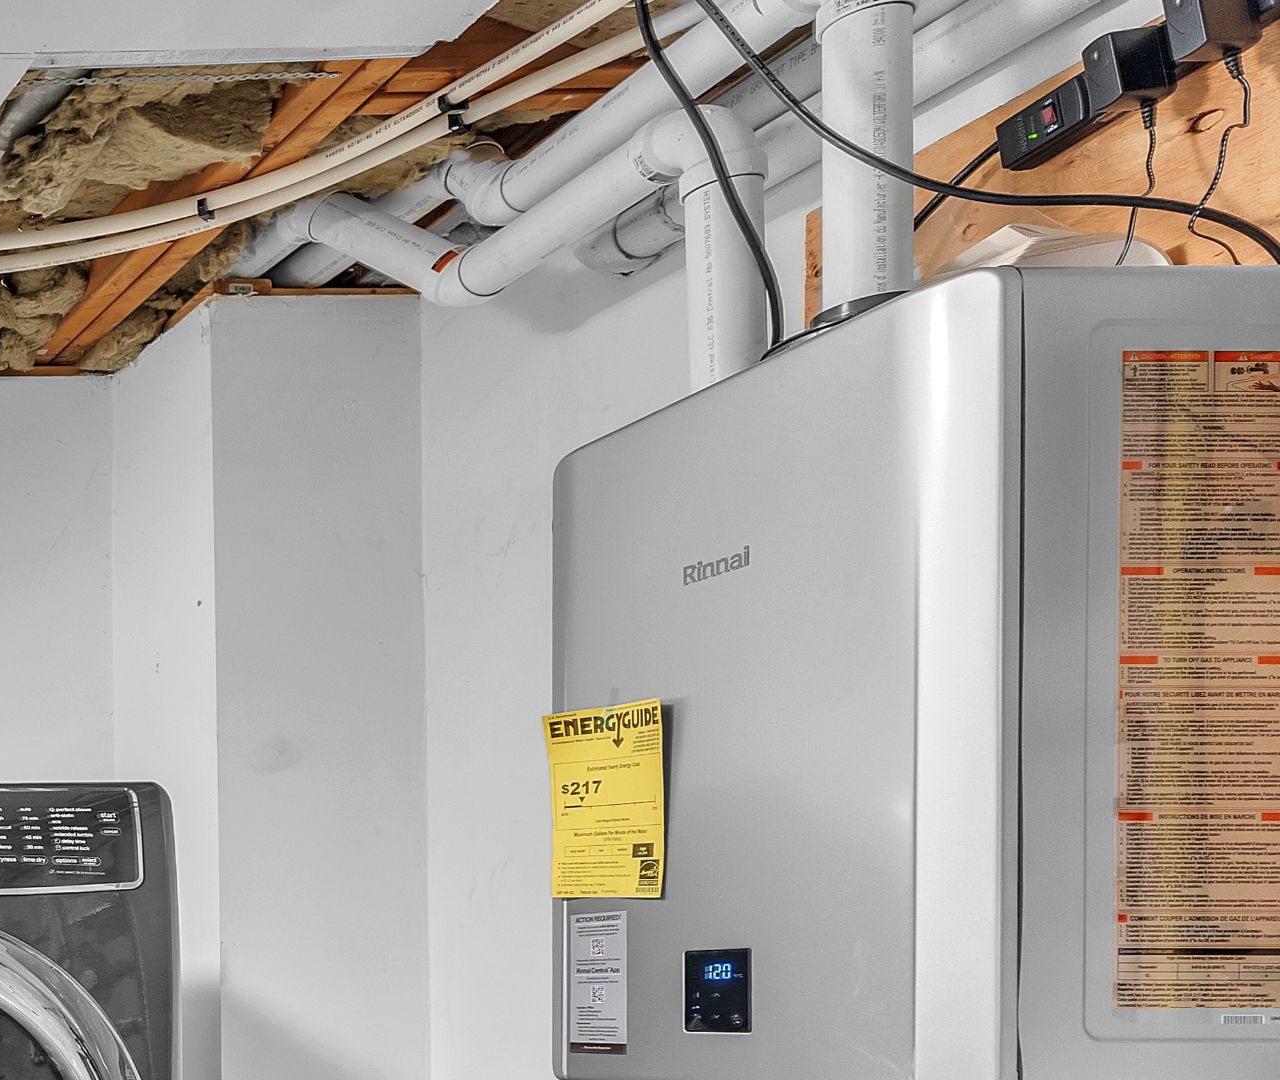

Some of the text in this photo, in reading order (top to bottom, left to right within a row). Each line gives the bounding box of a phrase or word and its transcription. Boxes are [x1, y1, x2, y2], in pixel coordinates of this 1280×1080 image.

[702, 190, 711, 220] SYSTEM
[683, 545, 749, 586] Rinnai
[561, 780, 602, 796] $217
[575, 914, 621, 924] ACTION REQUIRED!
[706, 963, 732, 980] 120
